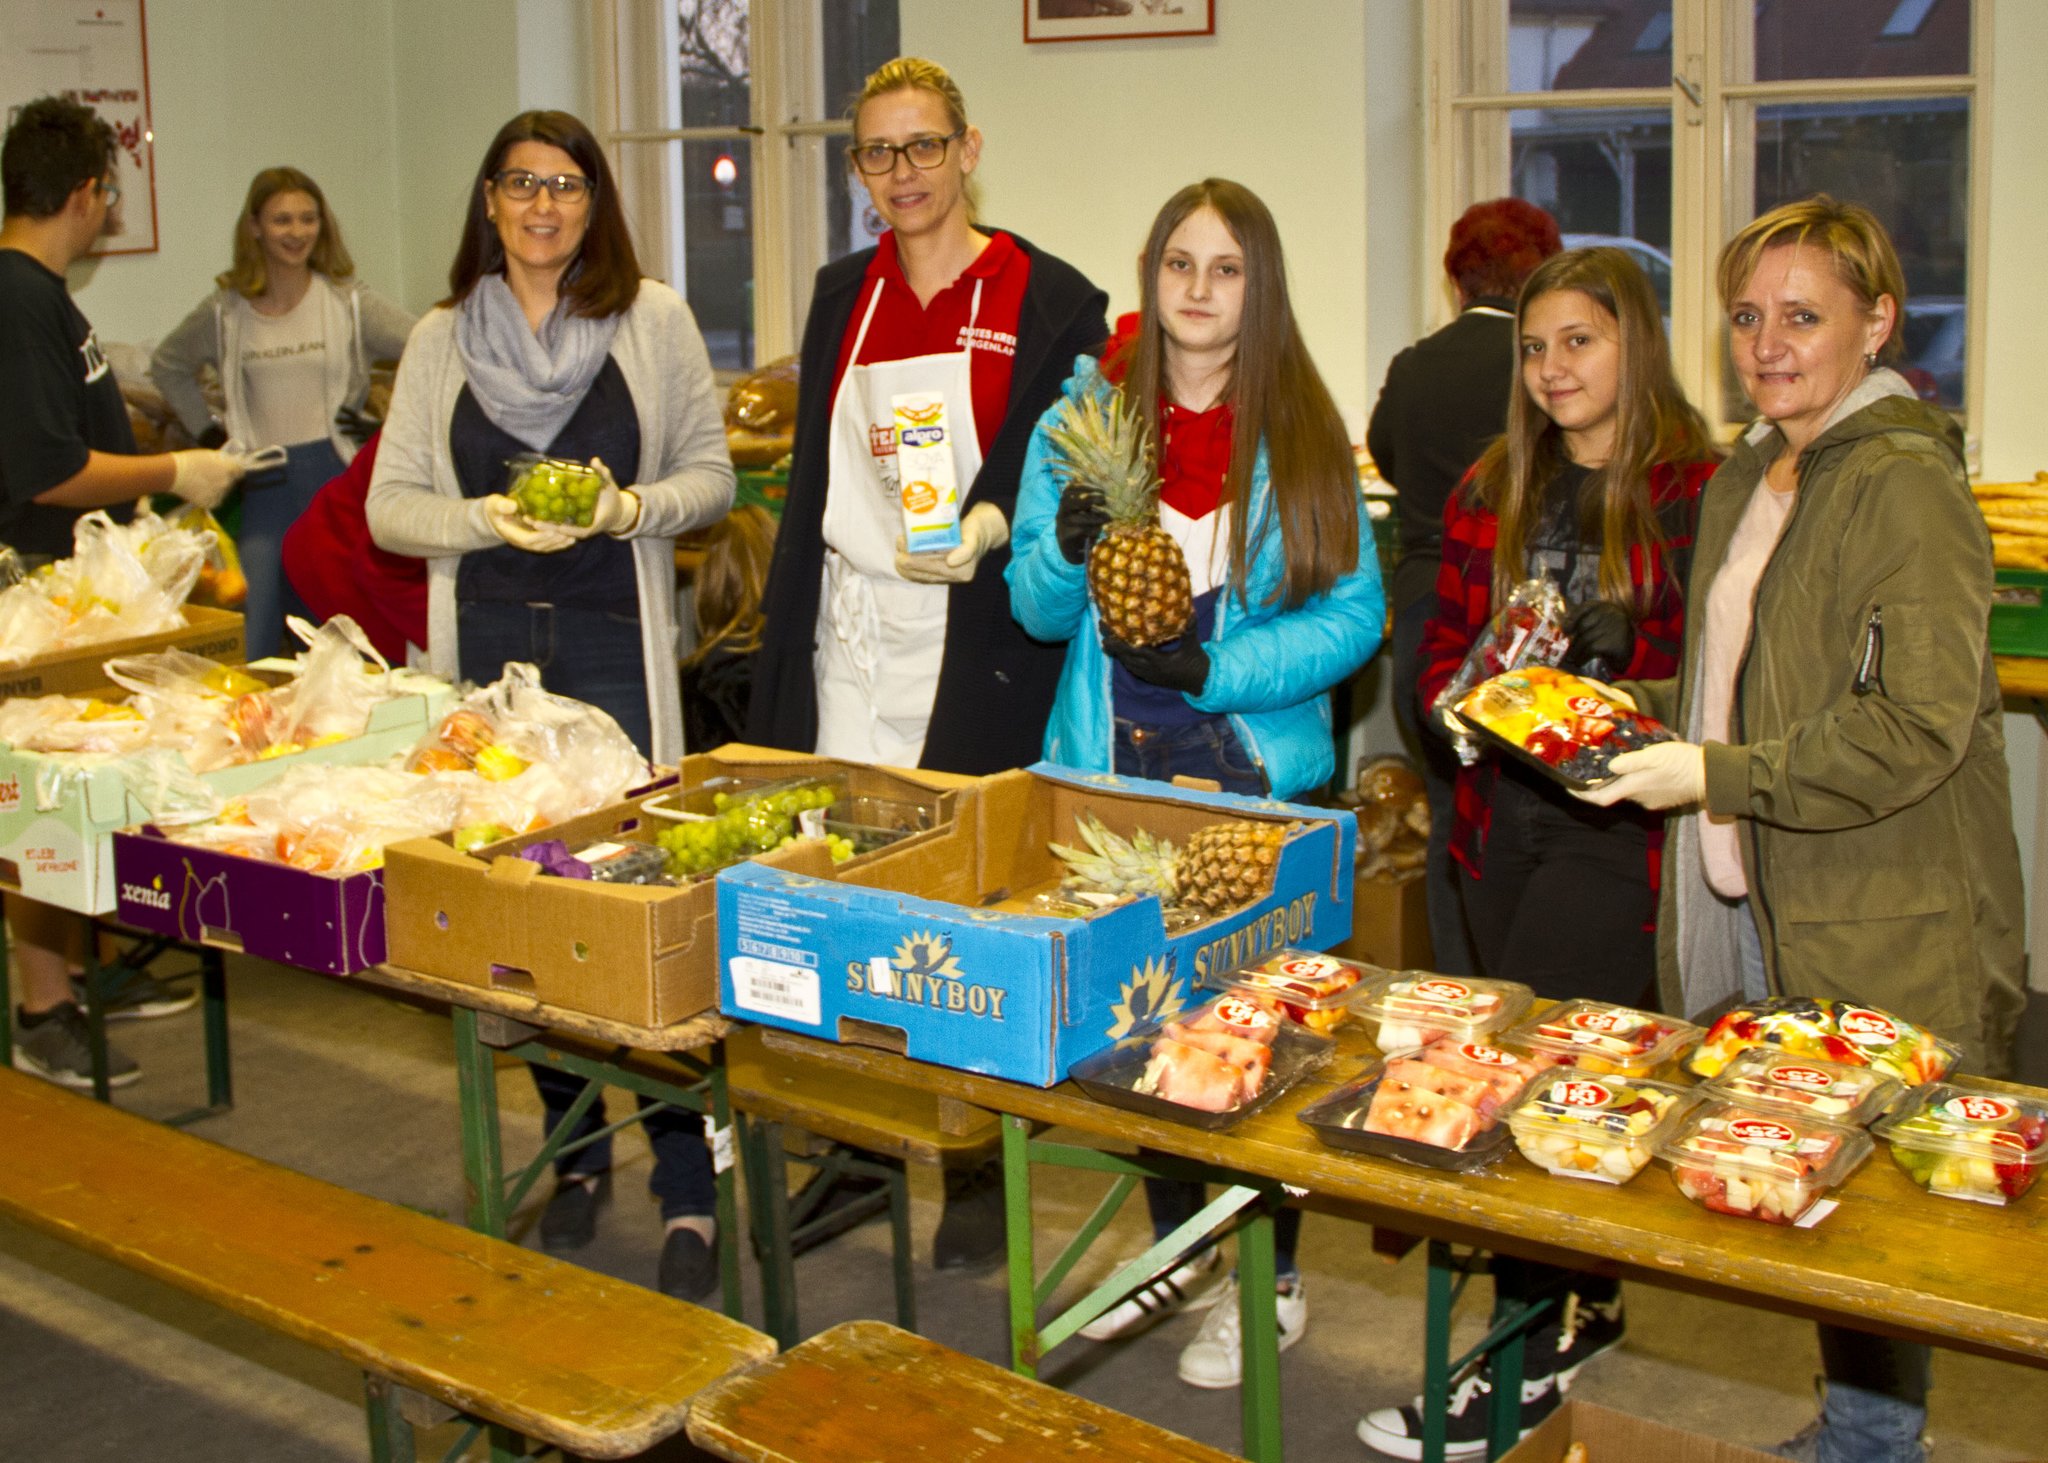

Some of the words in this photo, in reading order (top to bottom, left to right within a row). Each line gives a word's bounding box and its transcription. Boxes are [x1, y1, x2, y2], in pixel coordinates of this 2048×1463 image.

[904, 429, 942, 446] alpro
[121, 880, 171, 911] xenia
[1191, 890, 1317, 994] SUNNYBOY
[1731, 1124, 1791, 1139] -25%
